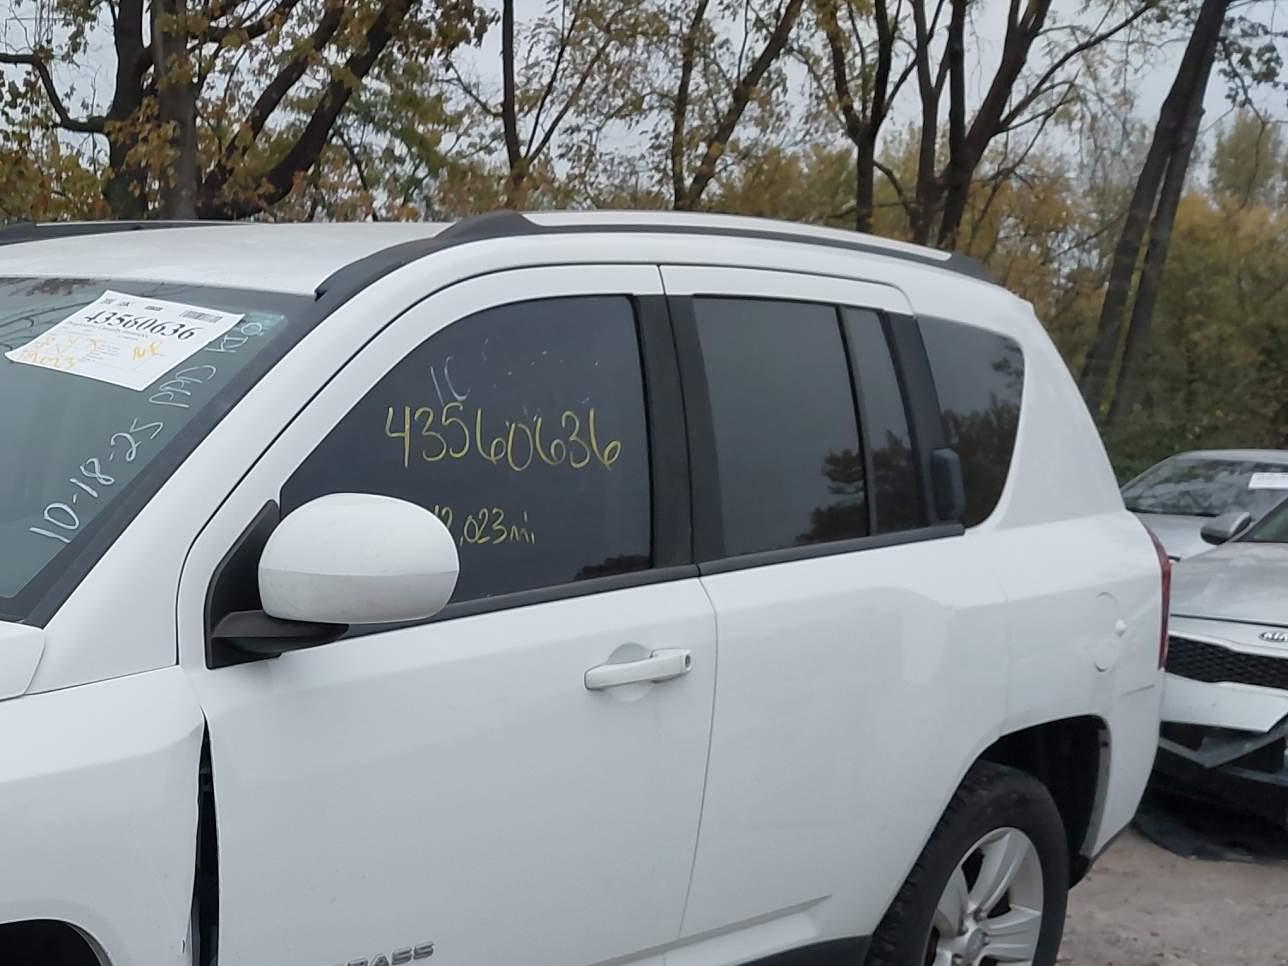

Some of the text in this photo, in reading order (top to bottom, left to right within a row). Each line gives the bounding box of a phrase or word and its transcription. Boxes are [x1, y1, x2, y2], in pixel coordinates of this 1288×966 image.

[84, 309, 203, 341] 43560636
[384, 401, 622, 471] 43560636
[29, 417, 163, 543] 10-18-25
